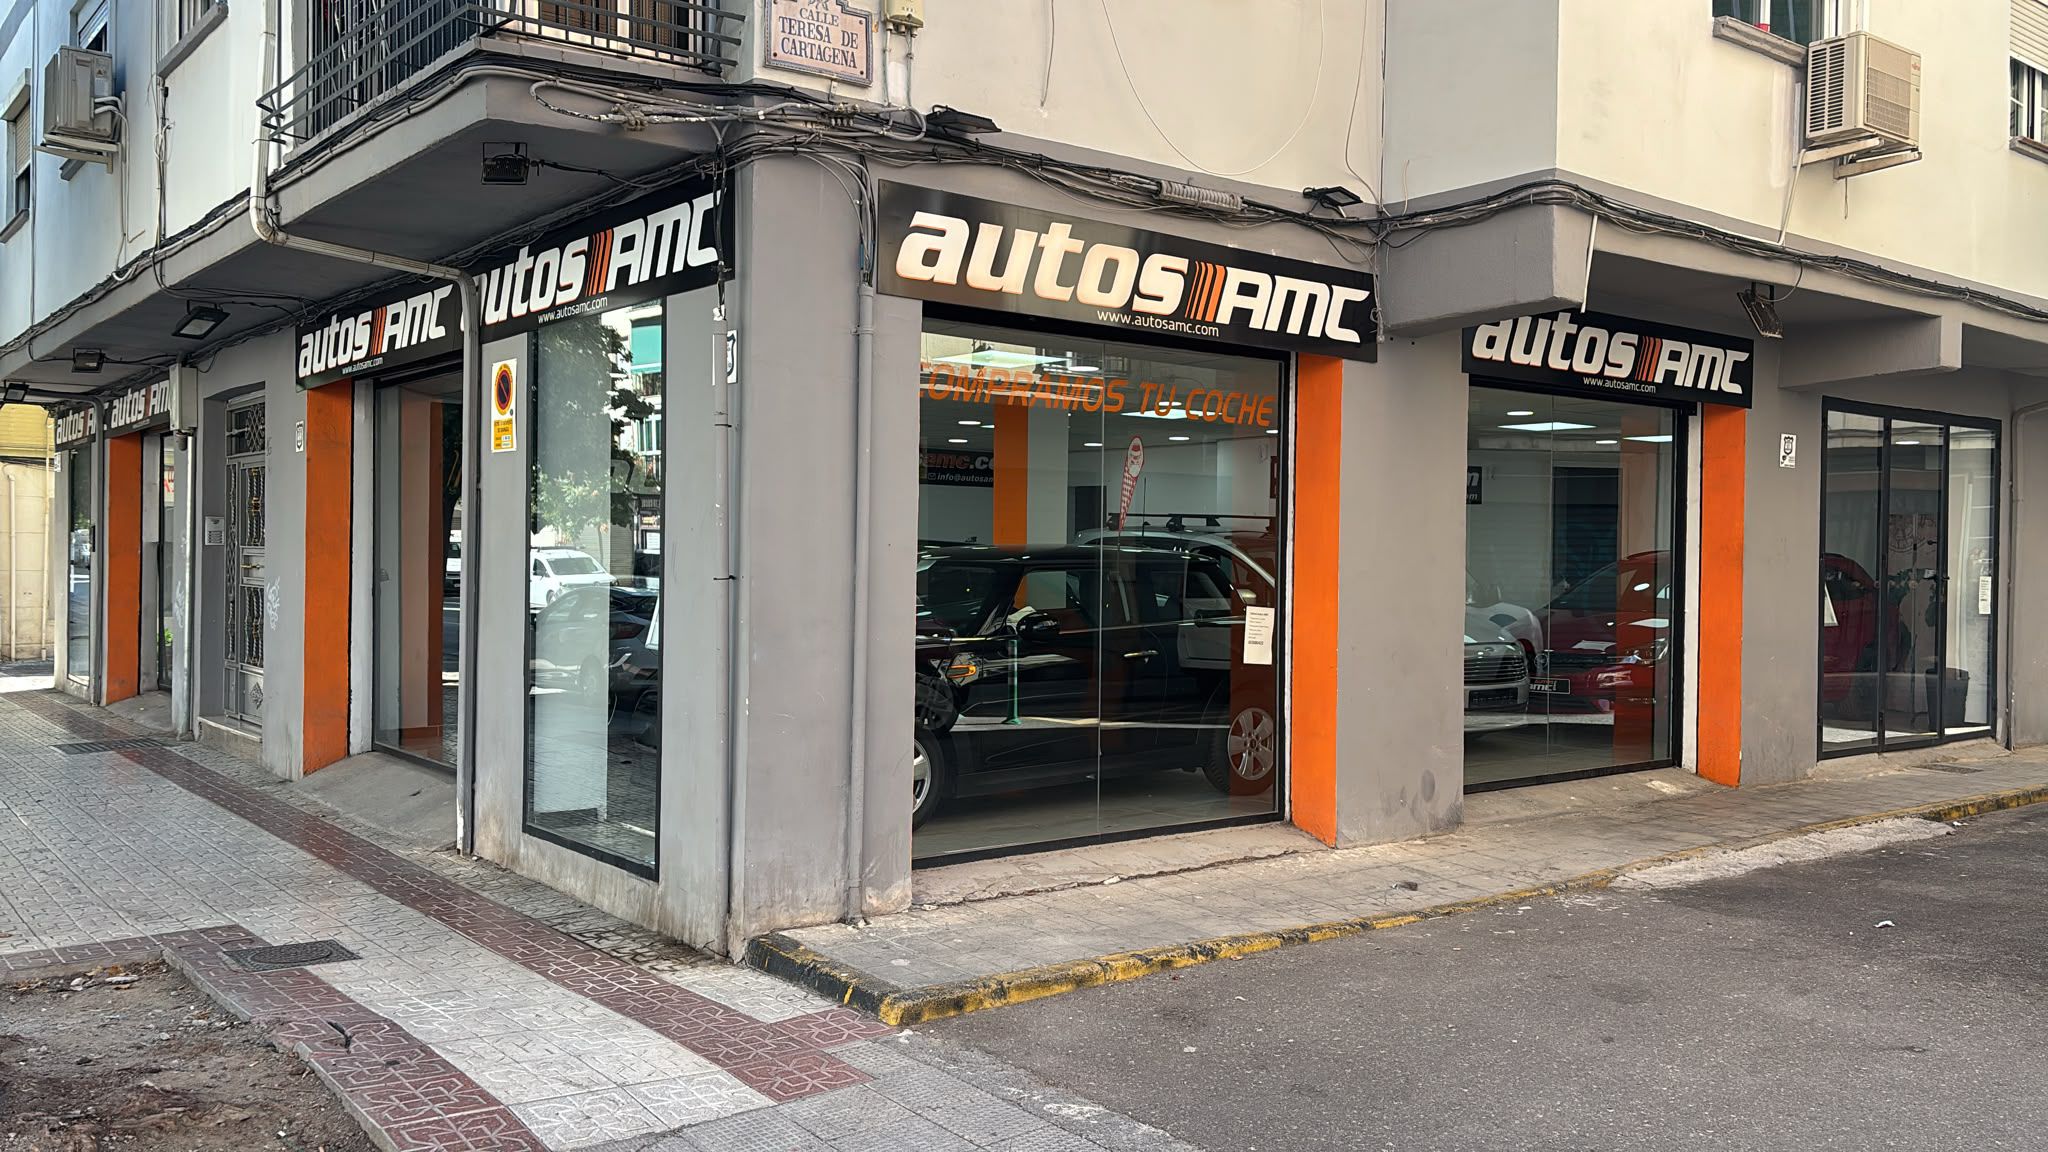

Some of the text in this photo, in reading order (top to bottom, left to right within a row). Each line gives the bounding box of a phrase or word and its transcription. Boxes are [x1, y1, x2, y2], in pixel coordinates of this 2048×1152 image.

[799, 7, 840, 27] CALLE
[779, 16, 859, 50] TERESA DE
[781, 37, 858, 69] CARTAGENA
[538, 296, 609, 323] www.autosamc.com
[1096, 309, 1220, 338] www.autosamc.com
[342, 356, 384, 375] www.autosamc.com
[149, 380, 171, 417] AM
[919, 362, 1277, 427] OMPRAMOS TU COCHE
[1583, 376, 1657, 394] www.autosamc.com
